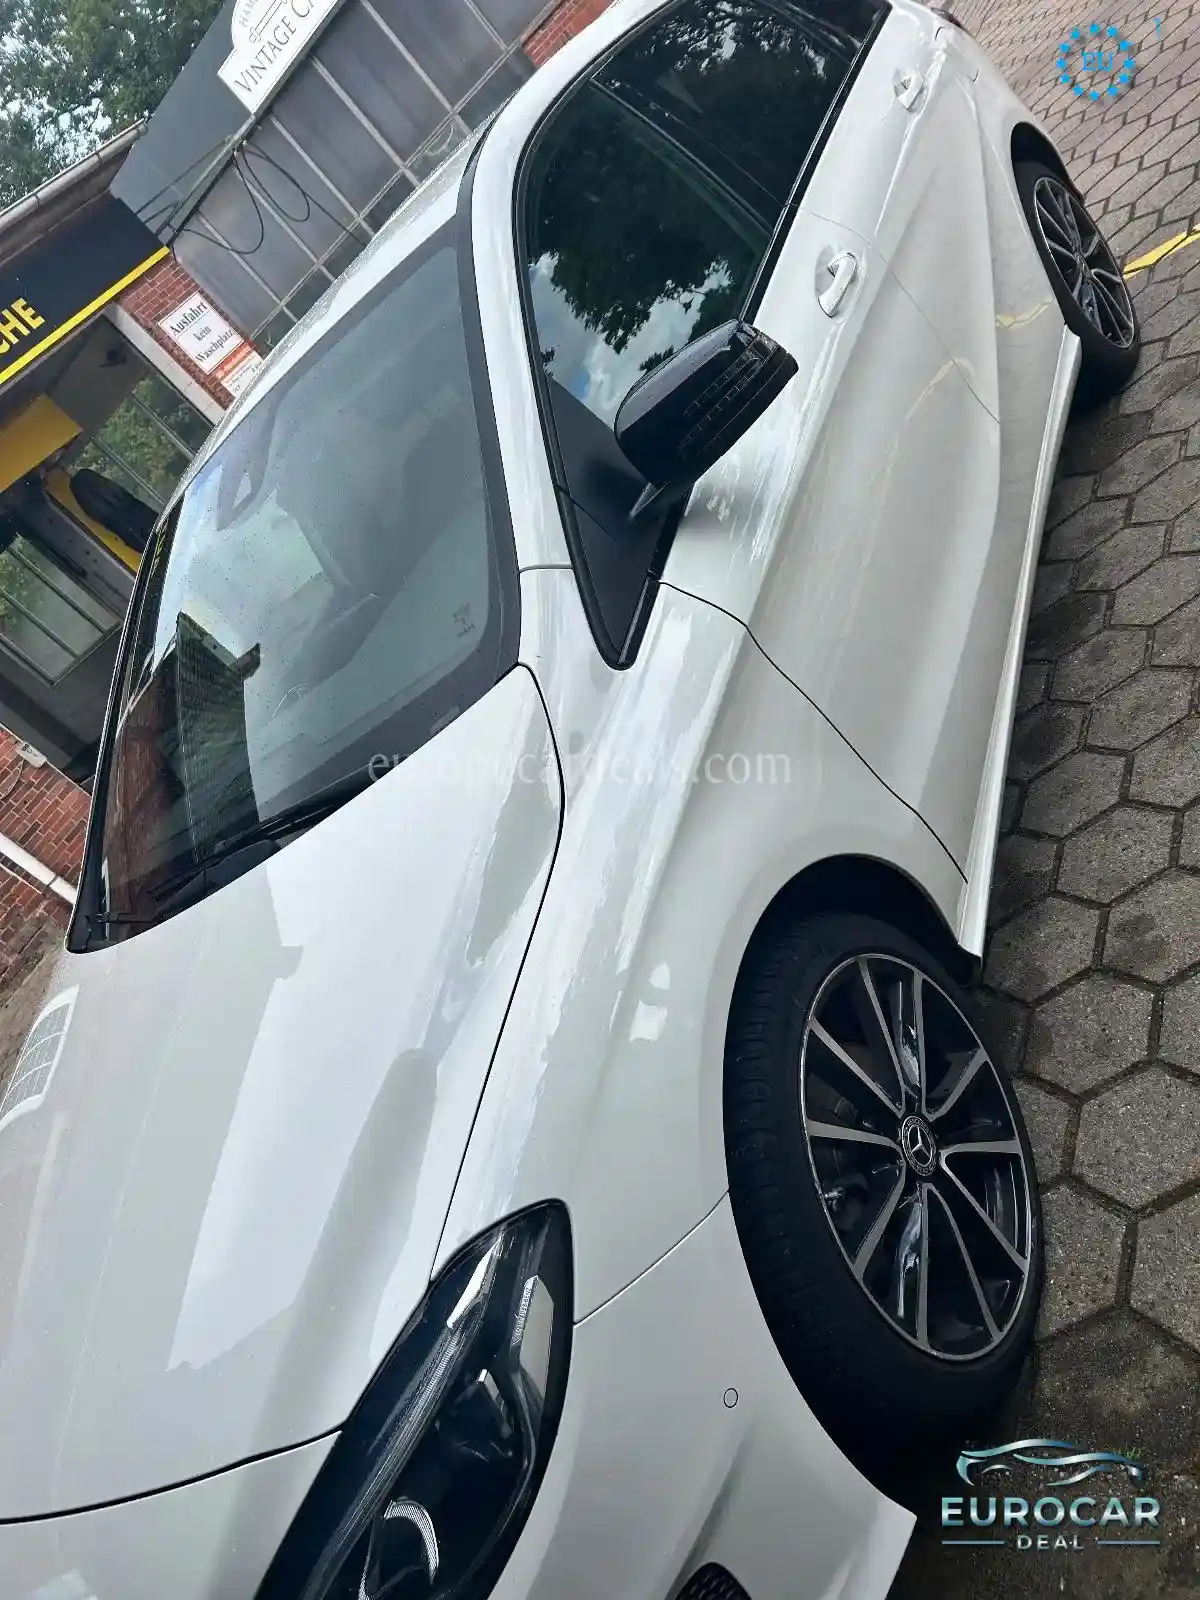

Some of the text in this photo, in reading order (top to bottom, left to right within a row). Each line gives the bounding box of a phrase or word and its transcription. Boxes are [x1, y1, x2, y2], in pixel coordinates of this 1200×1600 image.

[233, 0, 314, 92] VINTAGE C
[169, 301, 209, 337] Ausfahrt
[193, 325, 212, 342] kein
[195, 329, 234, 362] Waschplatz
